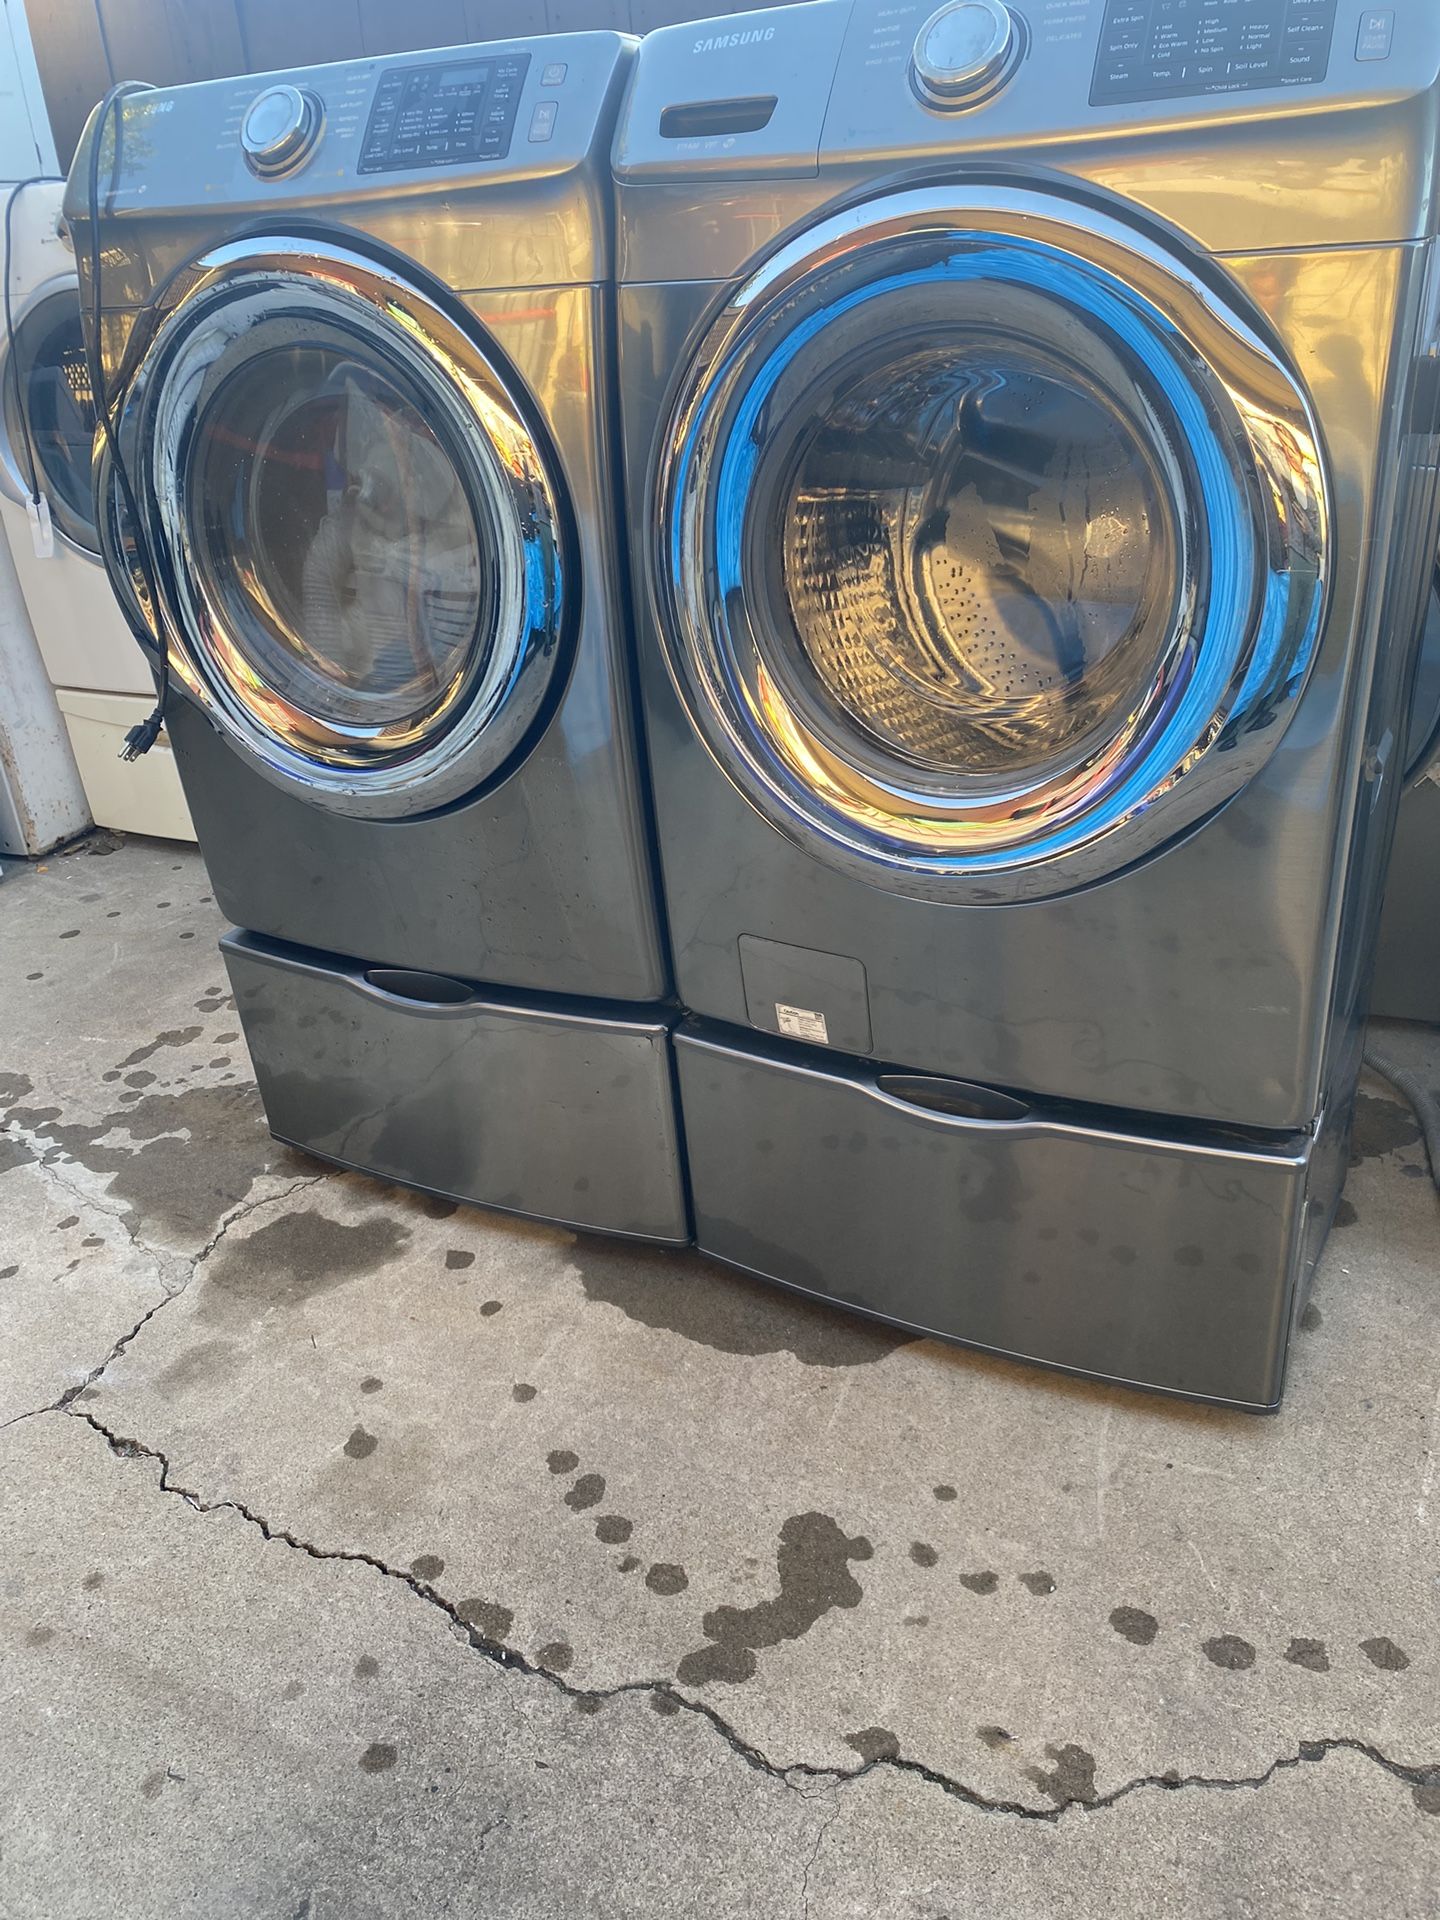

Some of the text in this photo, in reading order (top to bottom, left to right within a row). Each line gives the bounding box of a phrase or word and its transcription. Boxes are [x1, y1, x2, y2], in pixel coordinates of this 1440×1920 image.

[1113, 15, 1144, 24] Extra Spin
[693, 27, 775, 54] SAMSUNG
[1289, 56, 1311, 64] Sound
[1235, 61, 1268, 70] Soil Level
